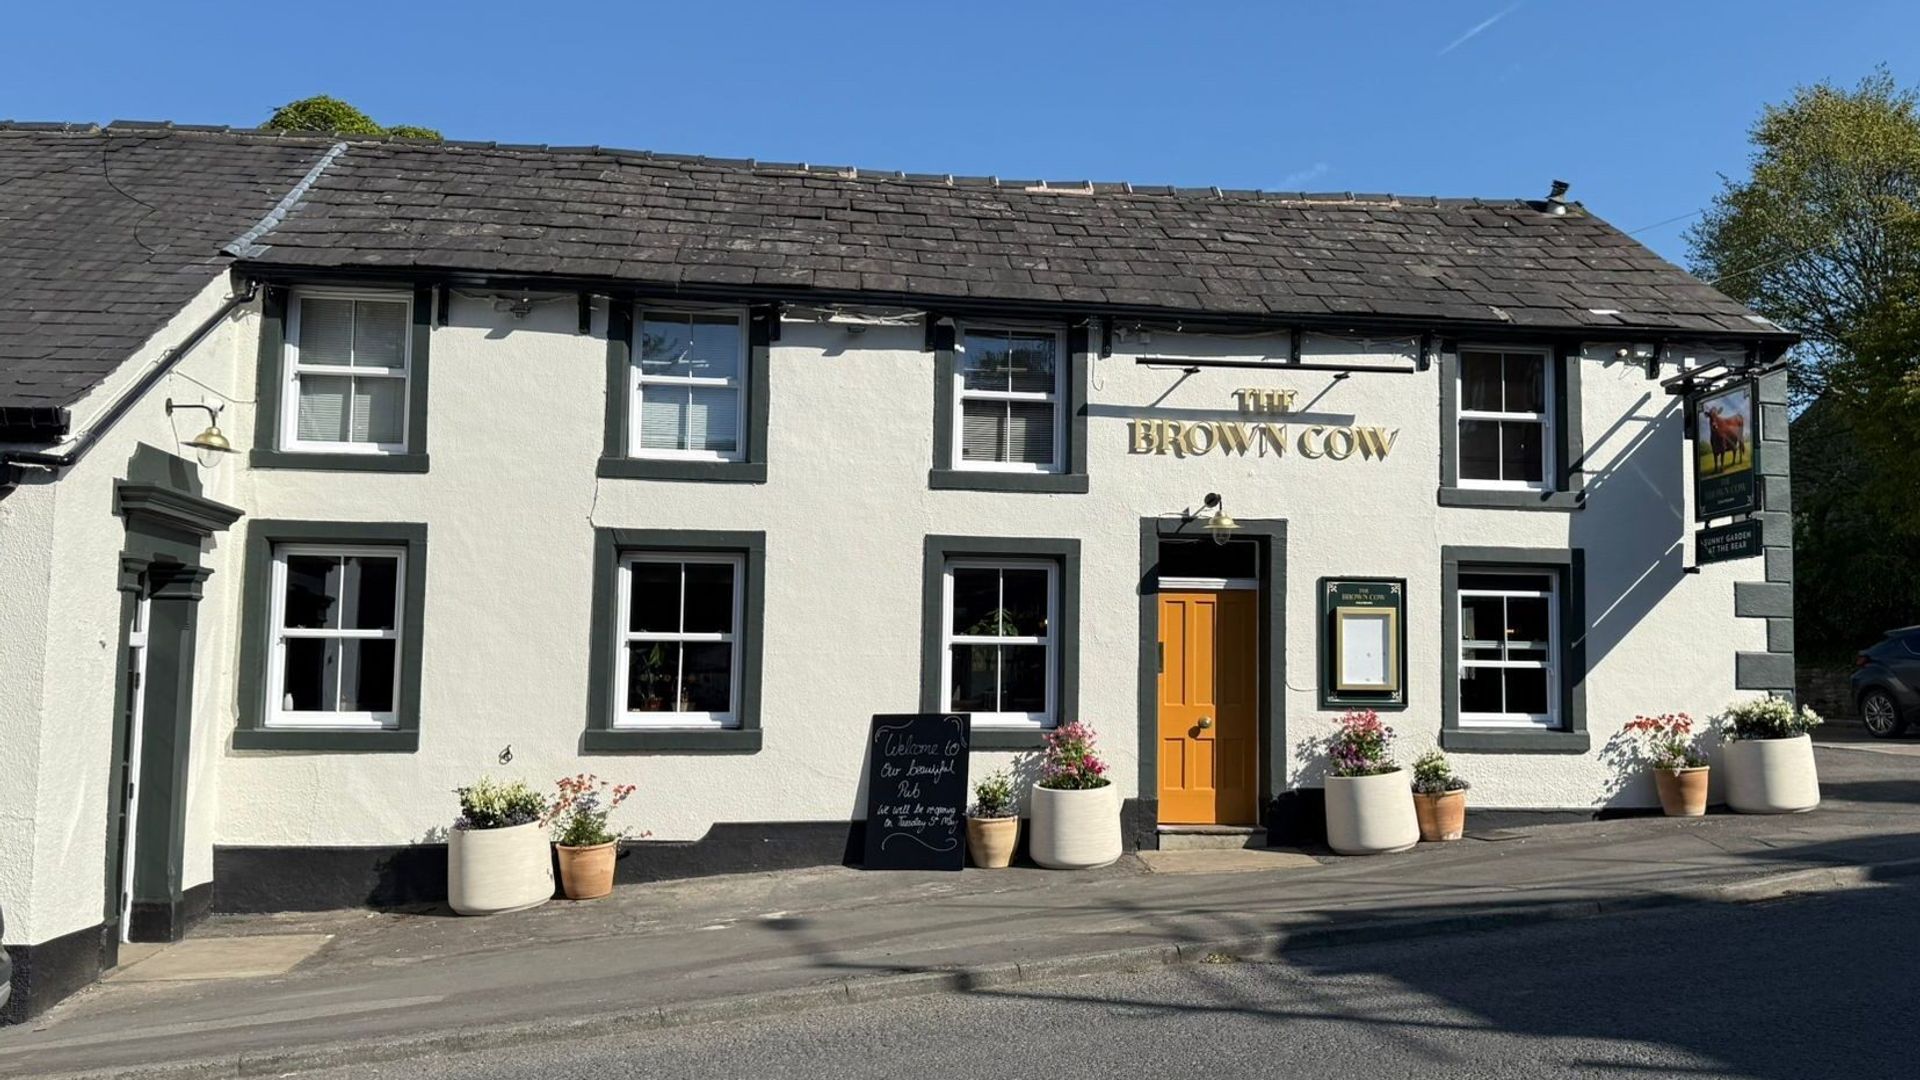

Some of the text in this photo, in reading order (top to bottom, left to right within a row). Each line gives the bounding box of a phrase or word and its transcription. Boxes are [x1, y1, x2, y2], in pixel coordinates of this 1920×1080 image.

[1232, 388, 1298, 414] THE
[1129, 418, 1400, 461] BROWN COW
[1704, 530, 1751, 545] SUNNY GARDEN
[1708, 540, 1747, 554] AT THE REAR
[885, 733, 961, 757] Welcome to
[897, 780, 920, 799] Pub
[877, 804, 890, 815] We
[892, 804, 911, 815] will
[913, 803, 924, 814] be
[898, 815, 927, 834] Tuesday
[940, 816, 959, 835] May
